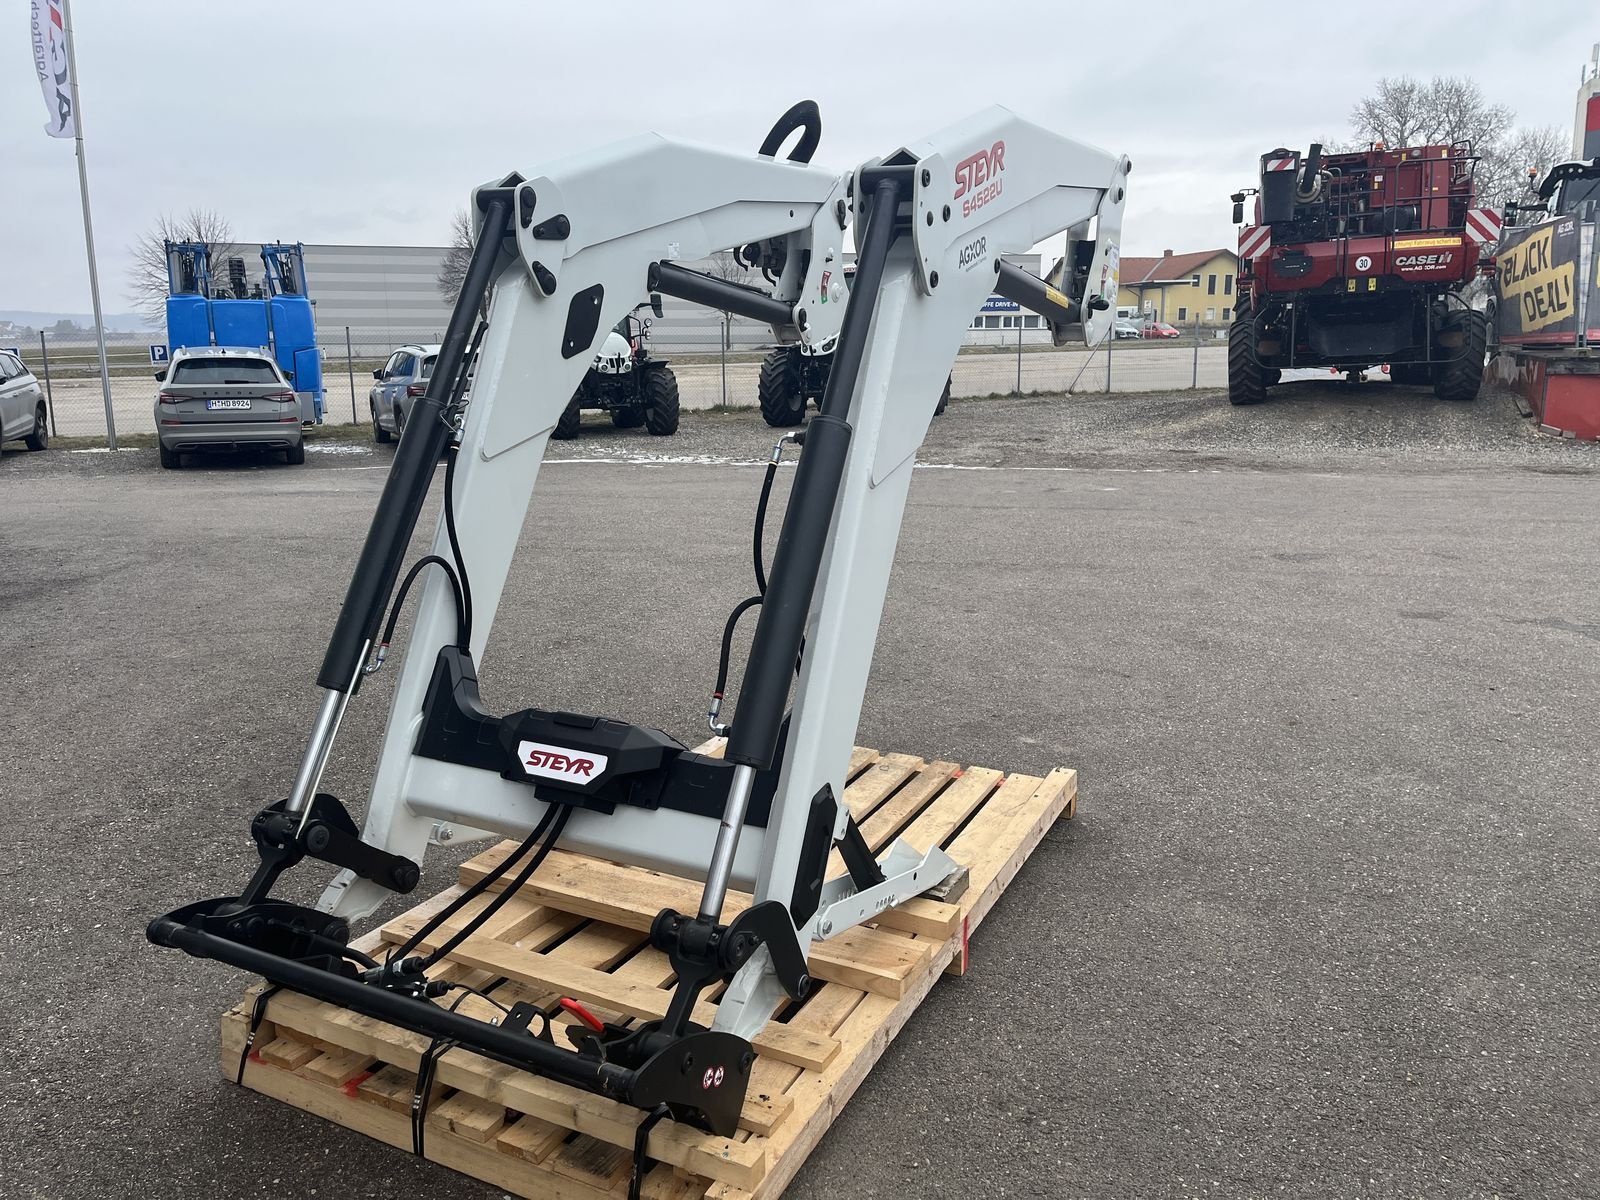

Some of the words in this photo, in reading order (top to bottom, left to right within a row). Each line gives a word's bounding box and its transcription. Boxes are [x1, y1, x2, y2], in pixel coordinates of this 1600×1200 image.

[954, 140, 1005, 200] STEYR
[963, 178, 1003, 218] S4522U
[959, 236, 987, 269] AGXOR
[1359, 259, 1368, 269] 30
[1396, 254, 1437, 266] CASE
[1503, 236, 1549, 288] BLACK
[1523, 275, 1570, 323] DEAL!
[155, 347, 164, 360] P
[525, 750, 594, 777] STEYR
